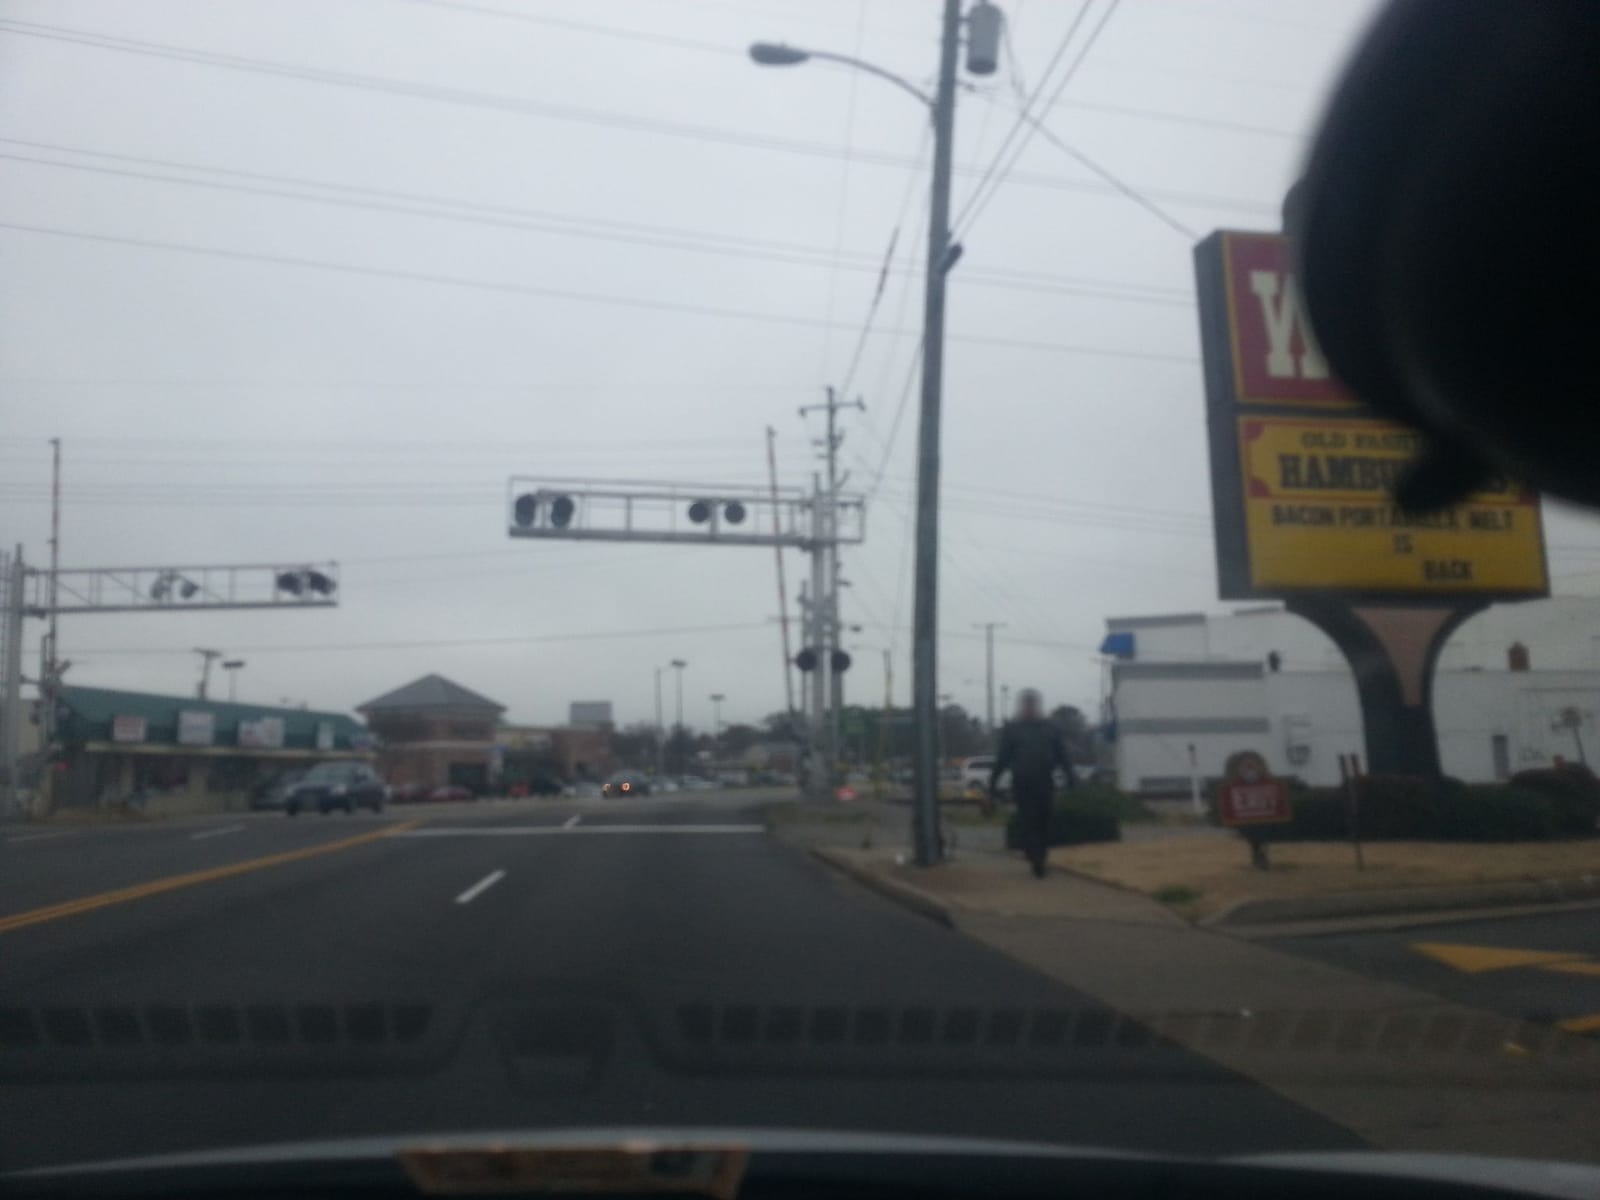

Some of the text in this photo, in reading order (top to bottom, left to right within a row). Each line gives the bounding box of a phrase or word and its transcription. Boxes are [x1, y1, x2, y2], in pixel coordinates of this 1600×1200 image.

[1272, 505, 1334, 526] BACON
[1393, 534, 1413, 554] IS
[1424, 560, 1473, 582] BACK
[1230, 784, 1279, 809] EXIT
